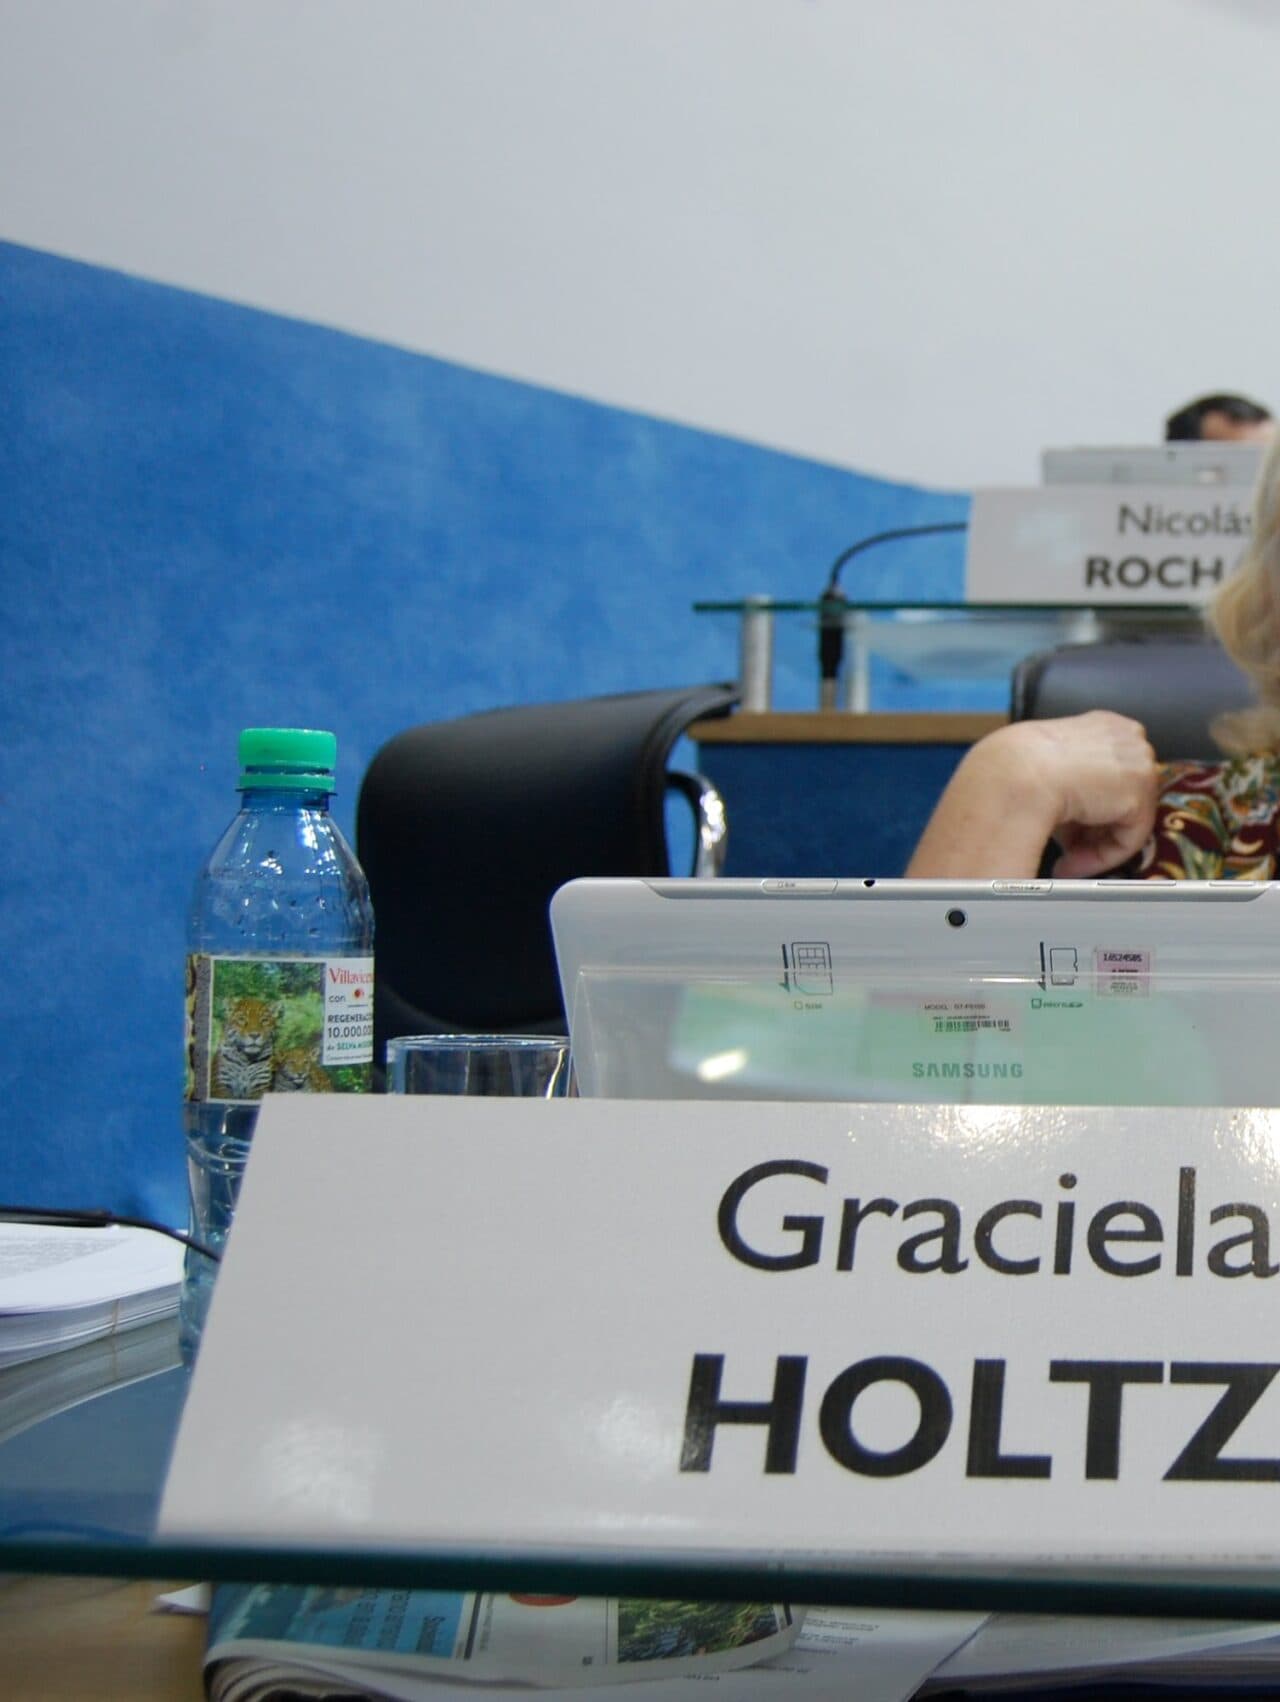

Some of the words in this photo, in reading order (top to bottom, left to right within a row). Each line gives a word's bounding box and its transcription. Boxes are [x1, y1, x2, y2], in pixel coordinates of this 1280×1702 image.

[328, 995, 346, 1003] con
[911, 1062, 1024, 1079] SAMSUNG
[717, 1158, 1280, 1279] Graciela
